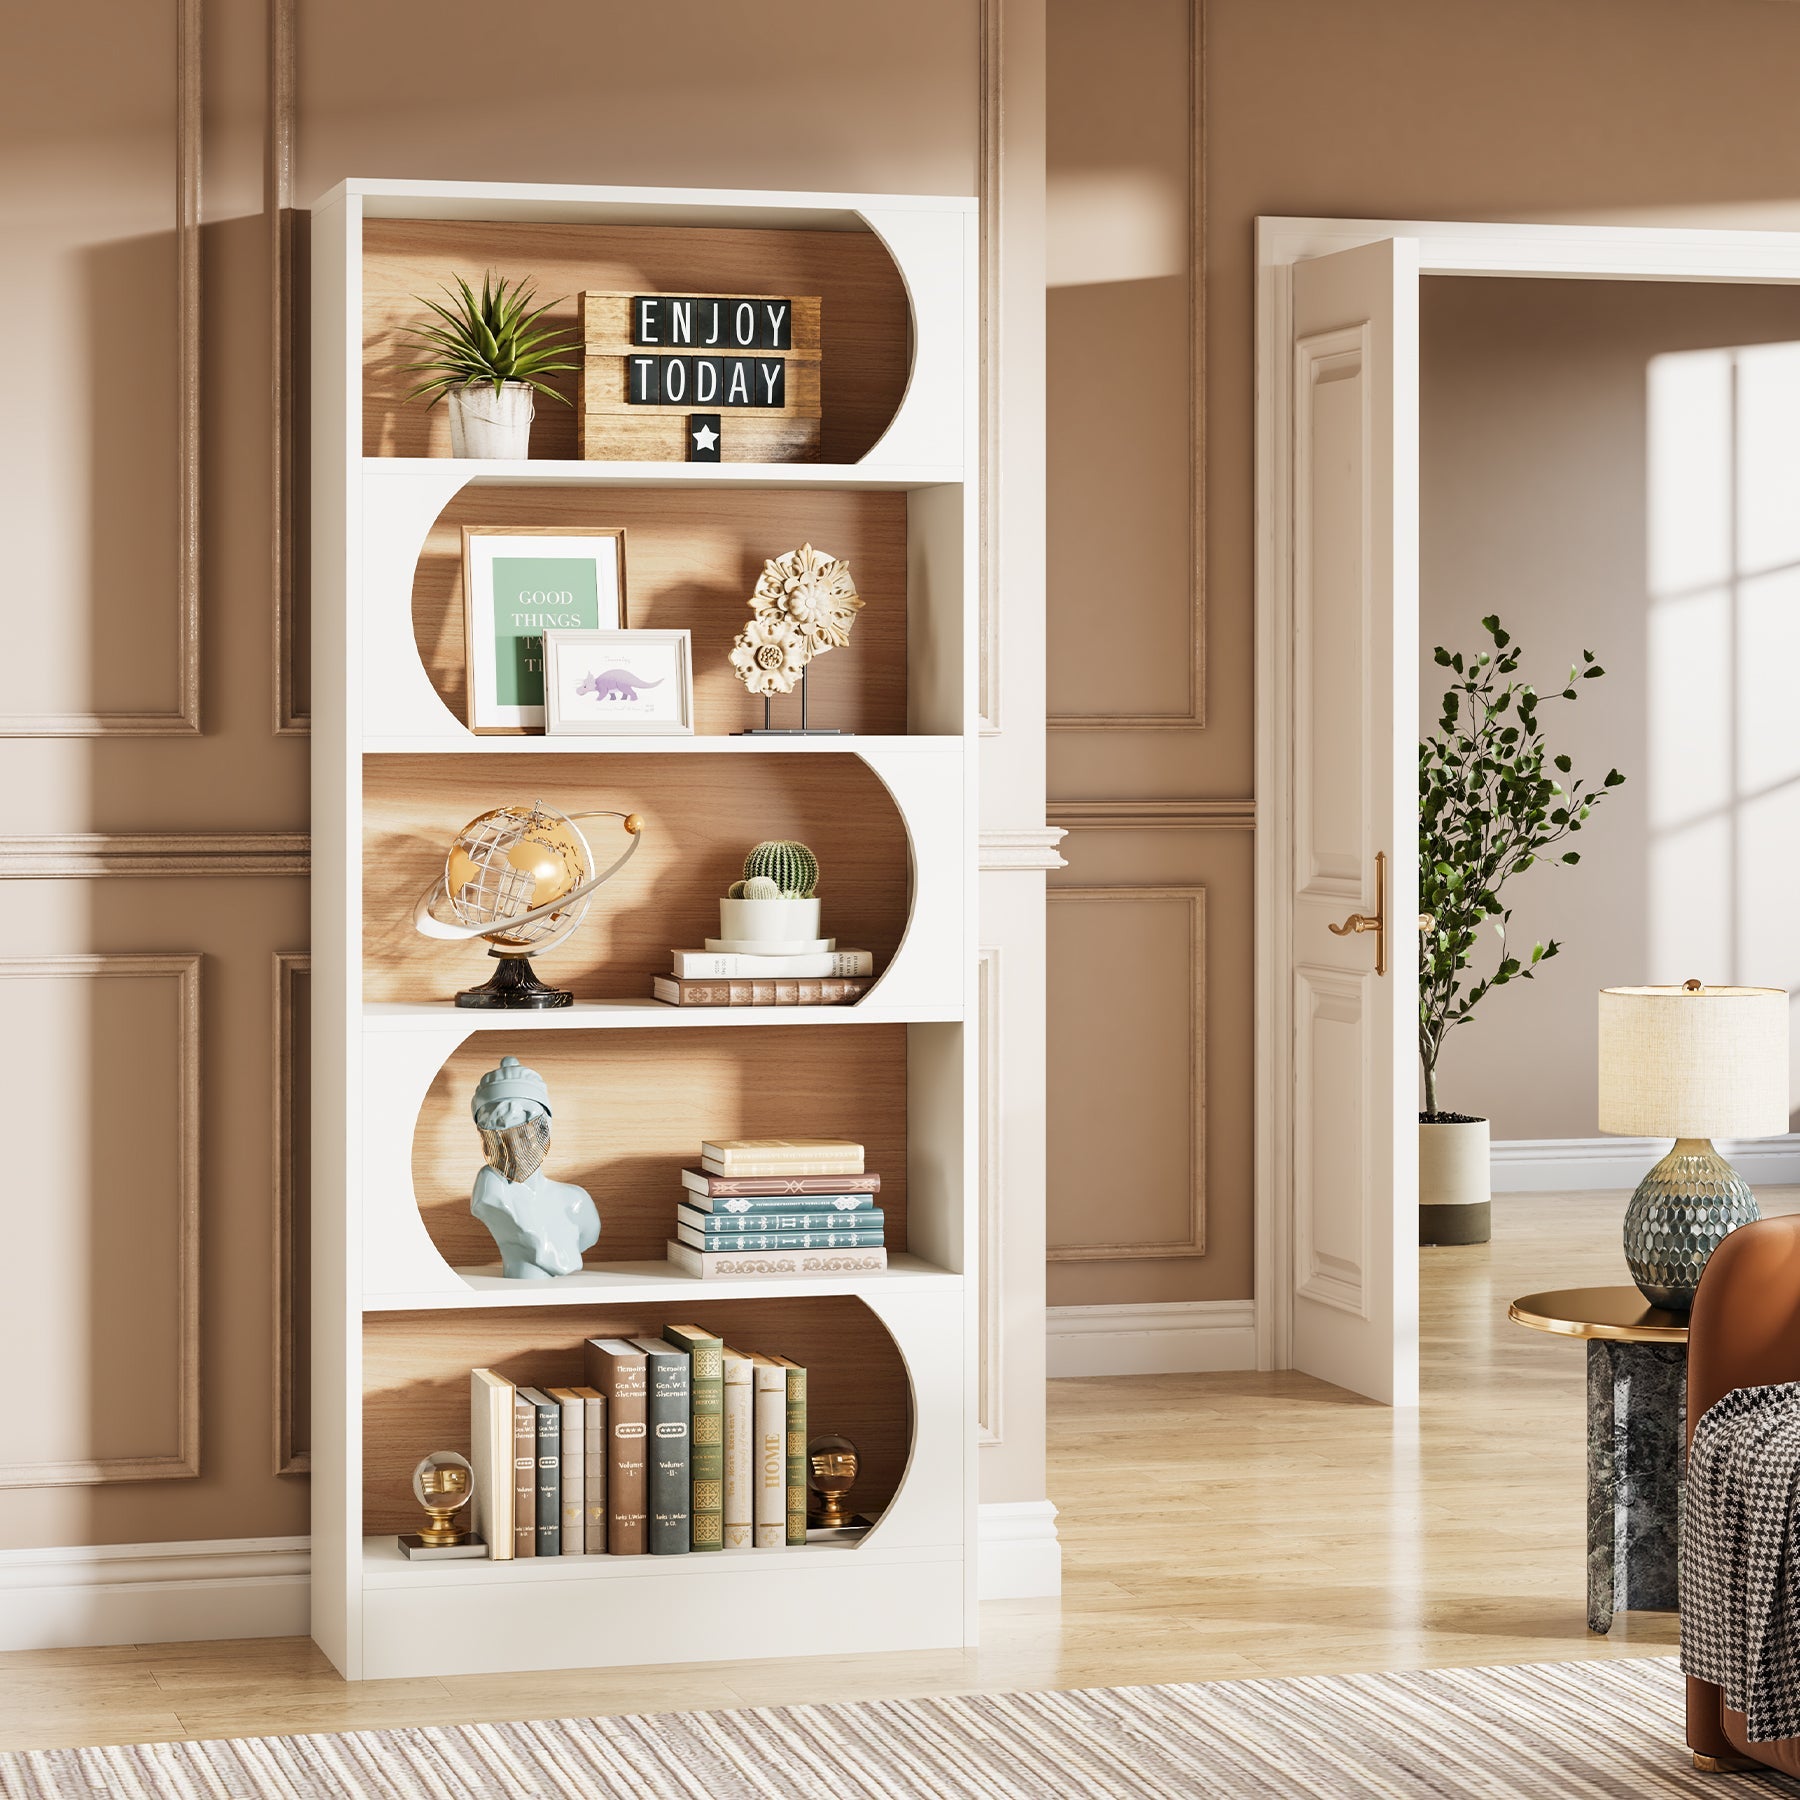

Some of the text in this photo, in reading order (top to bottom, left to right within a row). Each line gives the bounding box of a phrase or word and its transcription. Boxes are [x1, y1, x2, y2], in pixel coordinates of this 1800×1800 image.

[641, 300, 786, 347] ENJOY
[634, 358, 781, 405] TODAY
[519, 590, 573, 605] GOOD
[511, 613, 582, 628] THINGS
[522, 635, 544, 650] TA
[524, 658, 543, 672] TI
[617, 1365, 646, 1373] Memoirs
[628, 1373, 637, 1381] of
[655, 1390, 688, 1398] Sherman
[727, 1455, 735, 1476] Most
[765, 1433, 780, 1489] HOME
